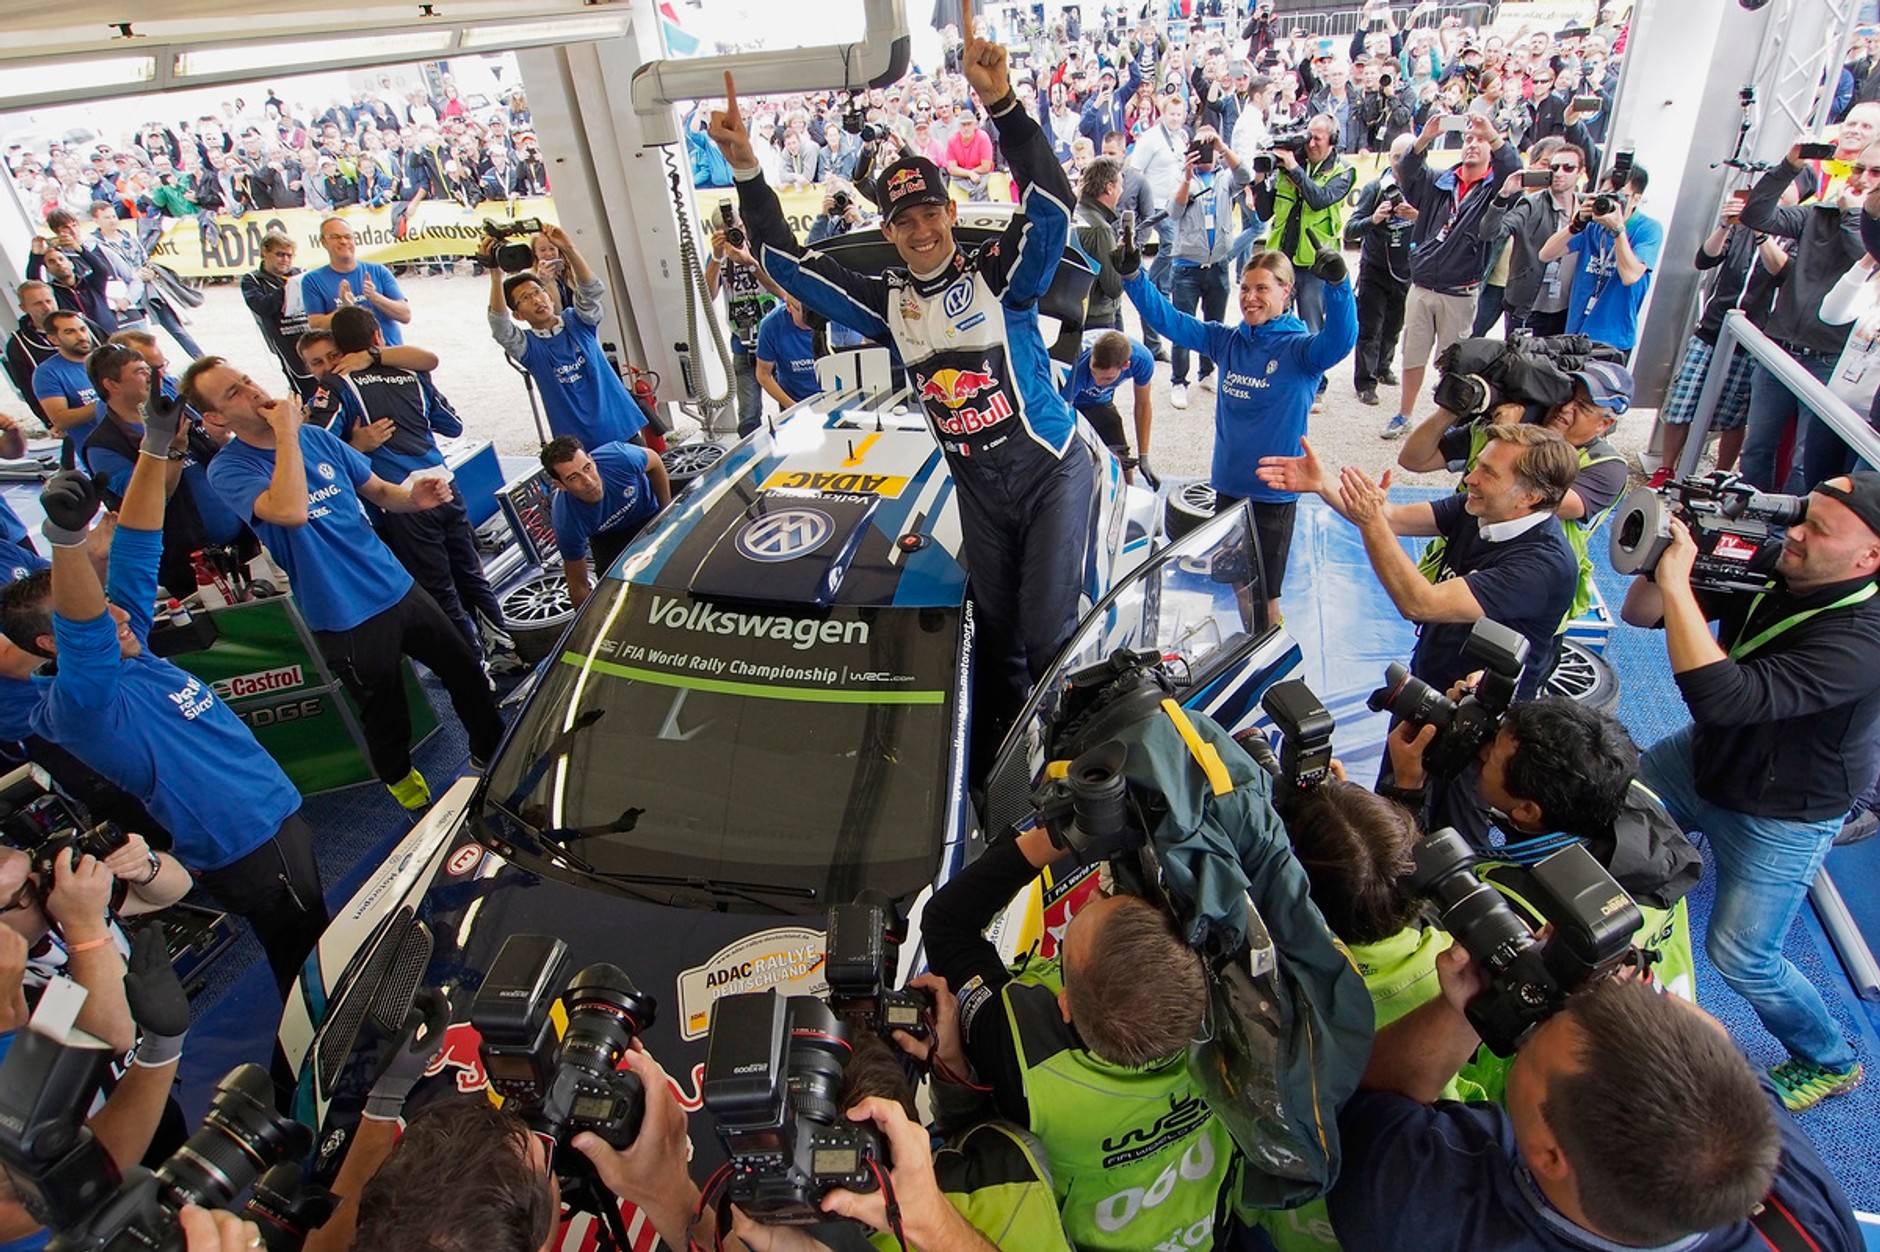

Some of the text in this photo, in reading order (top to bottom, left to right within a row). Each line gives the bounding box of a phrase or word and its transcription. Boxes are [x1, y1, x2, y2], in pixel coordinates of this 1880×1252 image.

[959, 390, 1014, 435] Bull
[782, 471, 889, 492] ADAC
[648, 595, 870, 650] Volkswagen
[231, 667, 302, 696] Castrol
[622, 645, 645, 661] FIA
[648, 648, 688, 667] World
[689, 656, 727, 675] Rally
[729, 660, 838, 685] Championship
[454, 849, 476, 869] E
[706, 943, 818, 989] ADAC RALLYE
[711, 962, 809, 1000] DEUTSCHLAND
